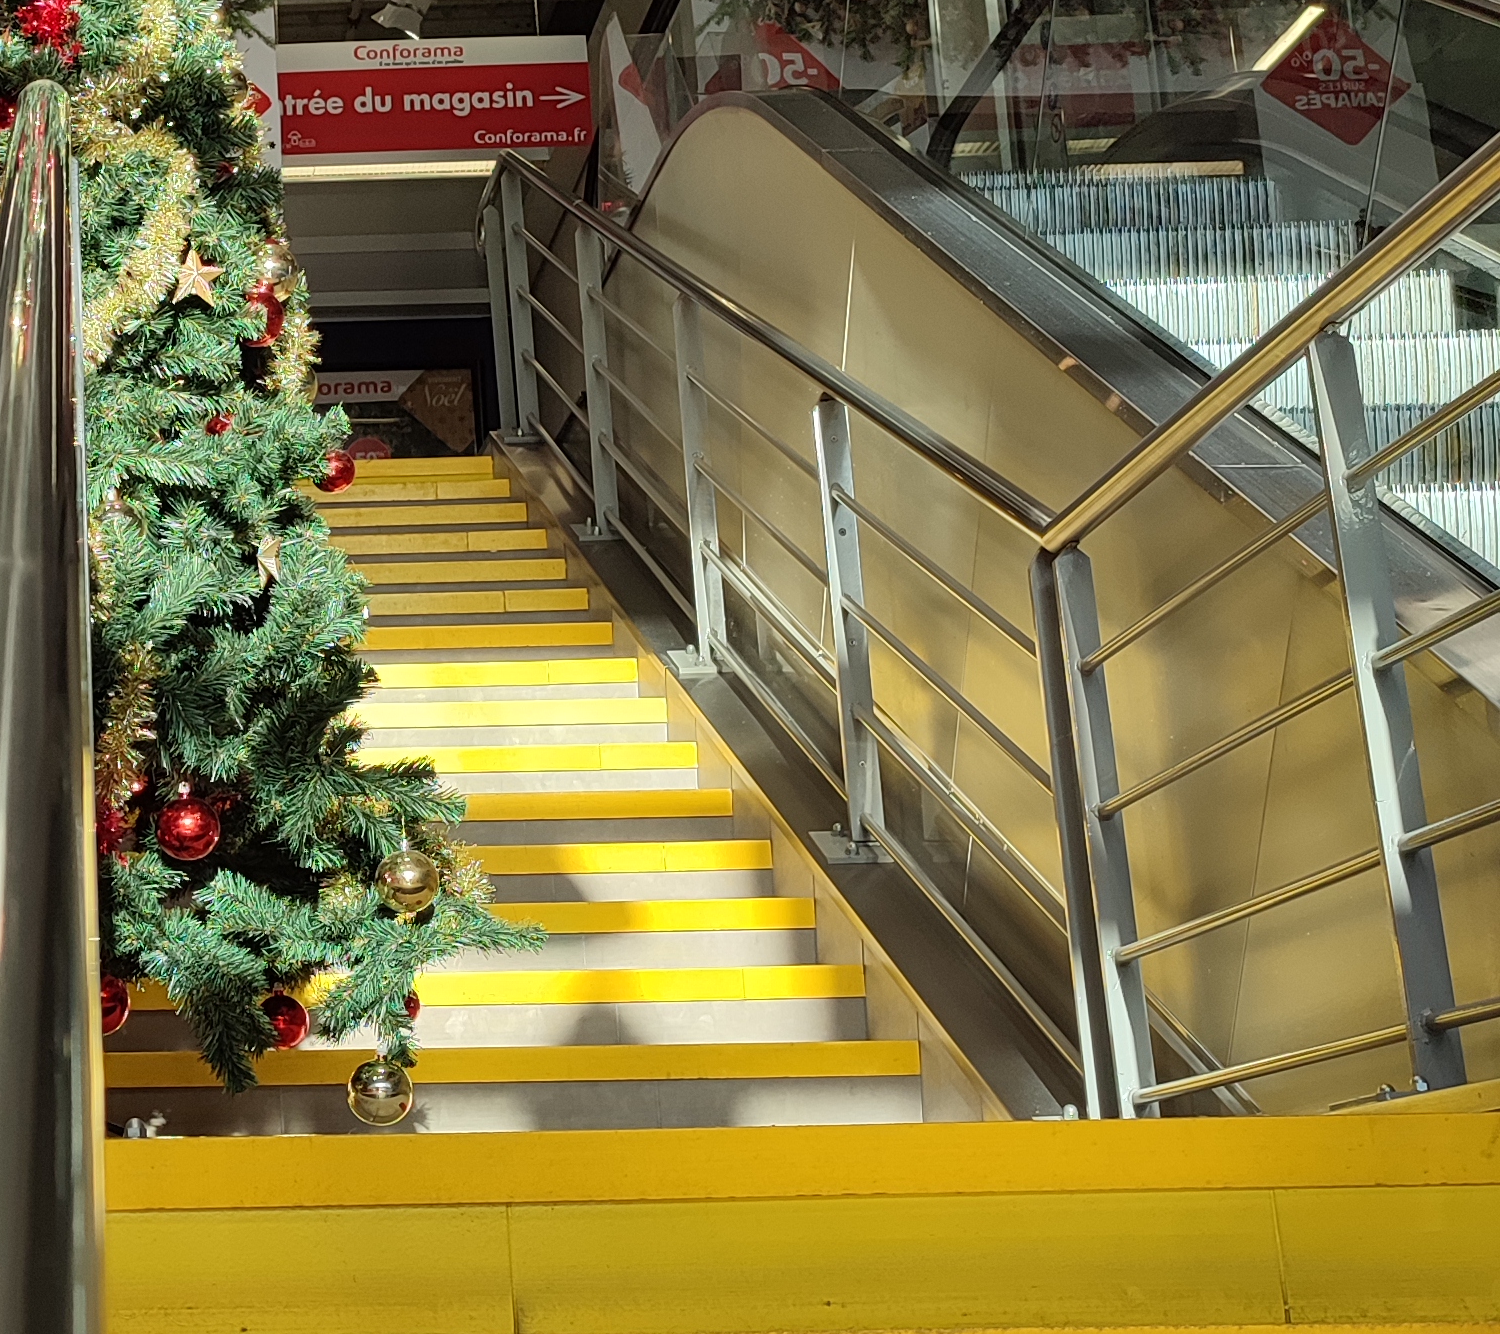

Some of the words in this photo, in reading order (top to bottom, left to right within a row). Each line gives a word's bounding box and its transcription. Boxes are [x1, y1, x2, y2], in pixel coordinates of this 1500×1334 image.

[353, 44, 464, 62] Conforama
[354, 86, 392, 113] du
[404, 82, 533, 116] magasin
[473, 127, 587, 145] Conforama.fr
[318, 379, 392, 396] orama
[424, 383, 468, 408] Noël
